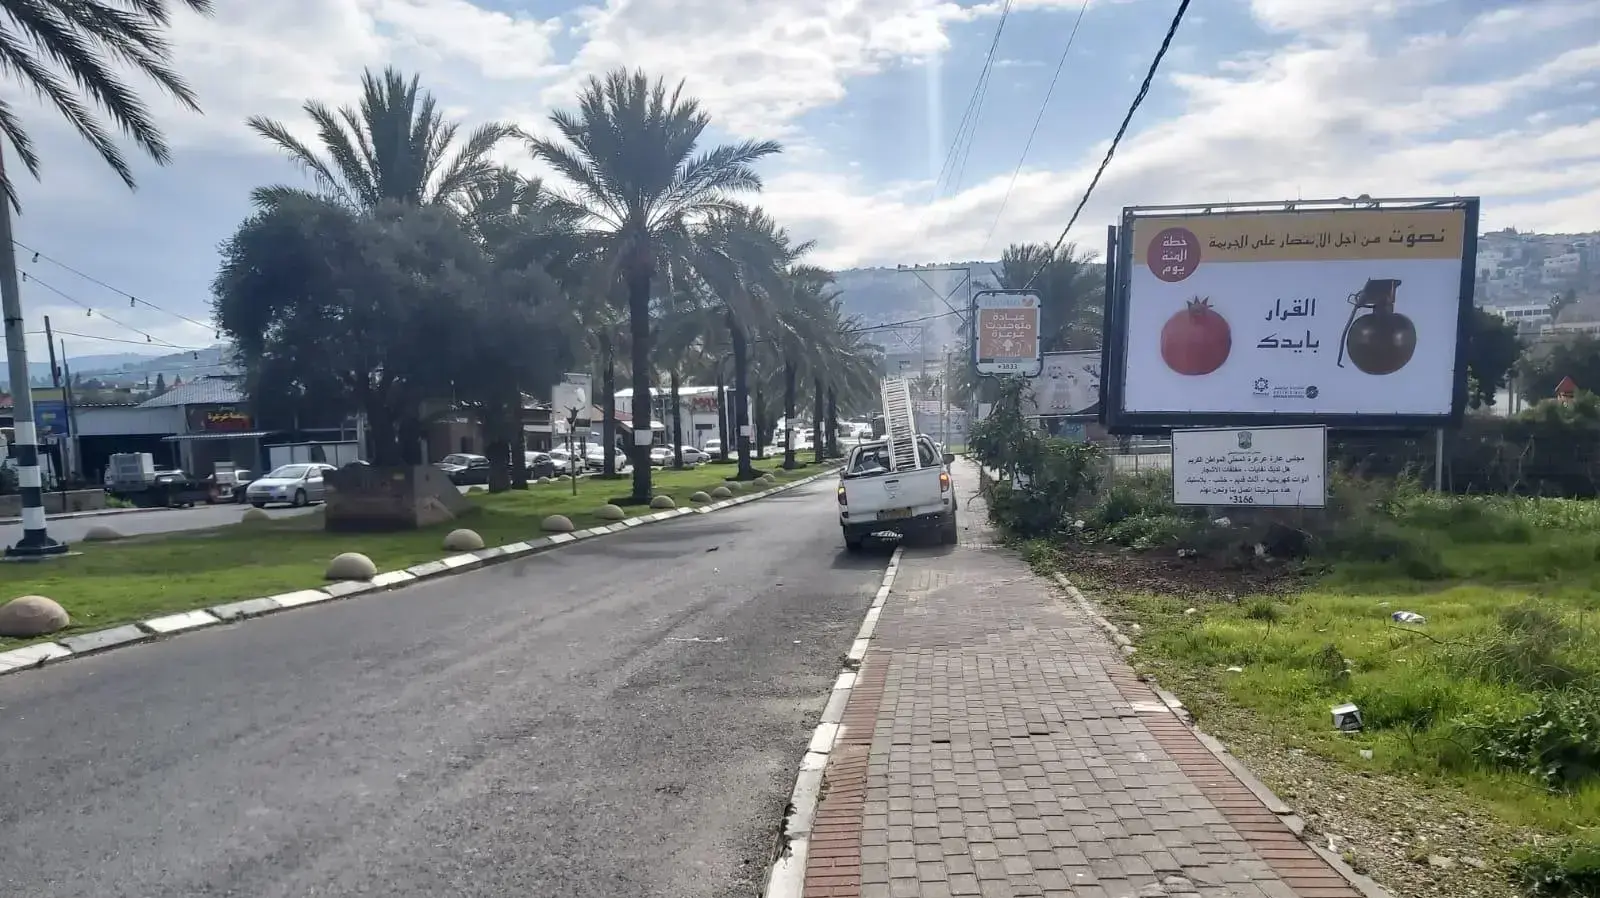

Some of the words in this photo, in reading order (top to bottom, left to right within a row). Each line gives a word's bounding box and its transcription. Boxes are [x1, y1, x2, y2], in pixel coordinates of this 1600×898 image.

[1162, 235, 1188, 247] خطة
[1209, 234, 1249, 250] الجريمة
[1252, 233, 1275, 249] على
[1361, 235, 1381, 248] من
[1162, 265, 1185, 275] يوم
[1265, 298, 1315, 321] القرار
[993, 313, 1025, 321] عيادة
[991, 330, 1025, 339] عرعرة
[1247, 455, 1267, 464] عرعرة
[1286, 455, 1305, 463] مجلس
